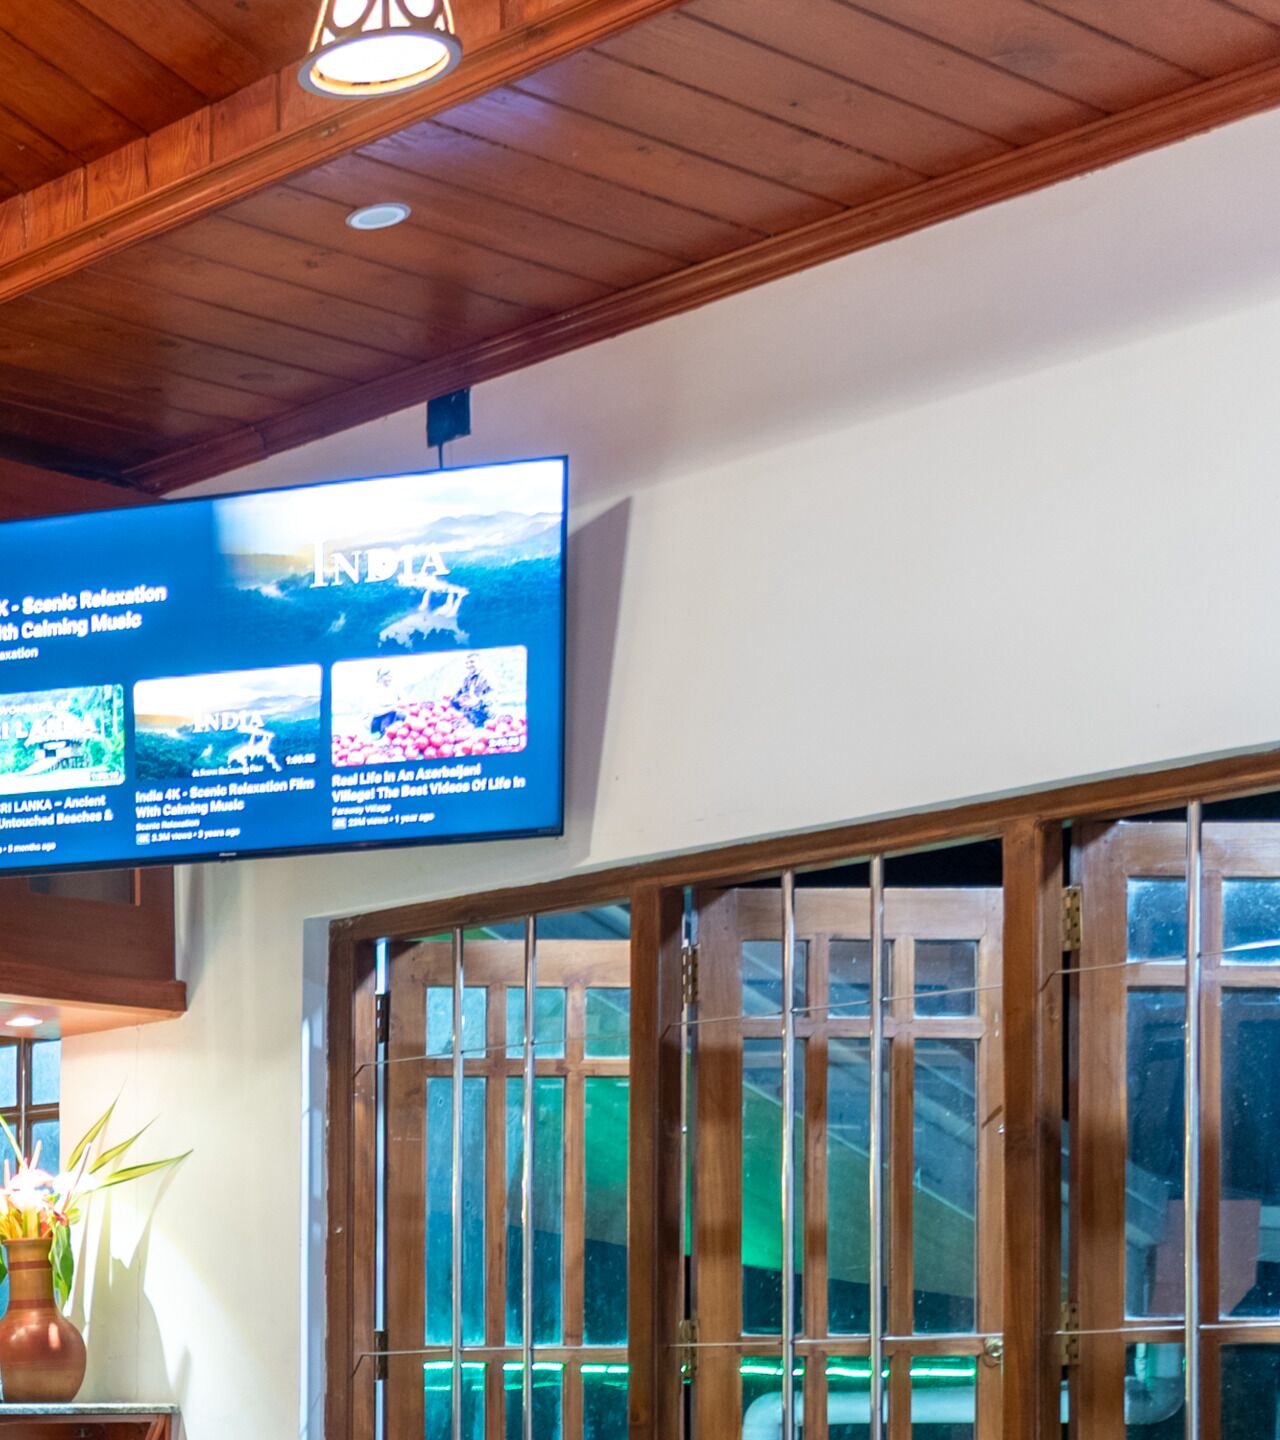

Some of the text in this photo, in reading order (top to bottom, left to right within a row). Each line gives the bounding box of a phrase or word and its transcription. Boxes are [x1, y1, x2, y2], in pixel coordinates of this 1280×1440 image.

[22, 594, 78, 616] Scenic
[79, 584, 167, 610] Relaxation
[20, 614, 89, 640] Calming
[90, 610, 142, 633] Music
[192, 710, 265, 733] INDIA
[331, 762, 482, 787] Real Life In An Azerbaijani
[135, 790, 163, 803] India
[164, 788, 181, 801] 4K
[189, 784, 228, 799] Scenic
[228, 778, 288, 796] Relaxation
[289, 777, 316, 791] Film
[331, 775, 526, 804] Village! The Best Videos Of Life In
[13, 798, 52, 813] LANKA
[63, 794, 107, 809] Ancient
[135, 799, 245, 819] With Calming Music
[56, 810, 103, 825] Beaches
[104, 808, 114, 821] &
[135, 818, 200, 832] Scenic Relaxation
[400, 813, 419, 825] year
[419, 811, 435, 823] ago
[171, 831, 192, 841] views
[204, 828, 225, 840] years
[225, 827, 241, 838] ago
[13, 842, 41, 853] months
[41, 841, 57, 852] ago
